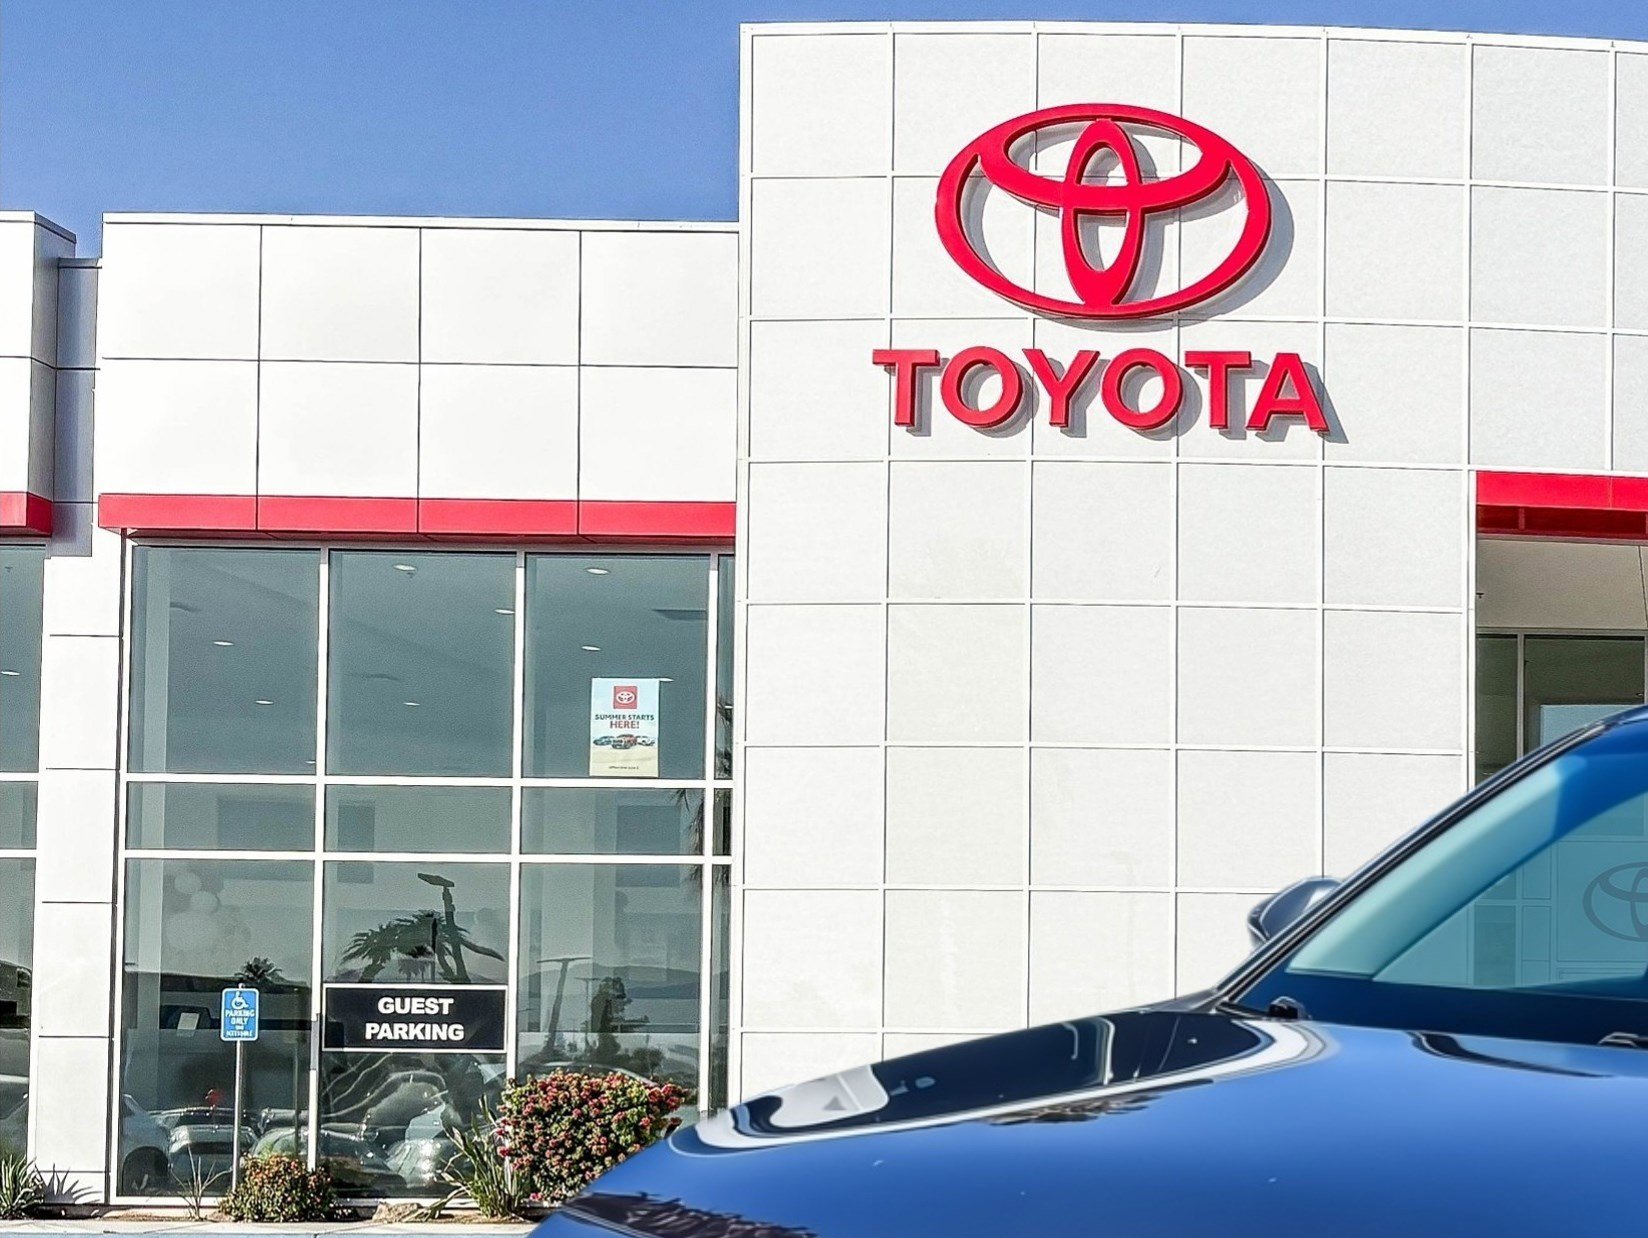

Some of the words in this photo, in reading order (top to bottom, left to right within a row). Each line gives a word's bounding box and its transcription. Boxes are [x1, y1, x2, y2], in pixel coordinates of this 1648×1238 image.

[872, 346, 1330, 432] TOYOTA
[609, 720, 640, 729] HERE!
[377, 996, 455, 1015] GUEST
[364, 1023, 465, 1041] PARKING
